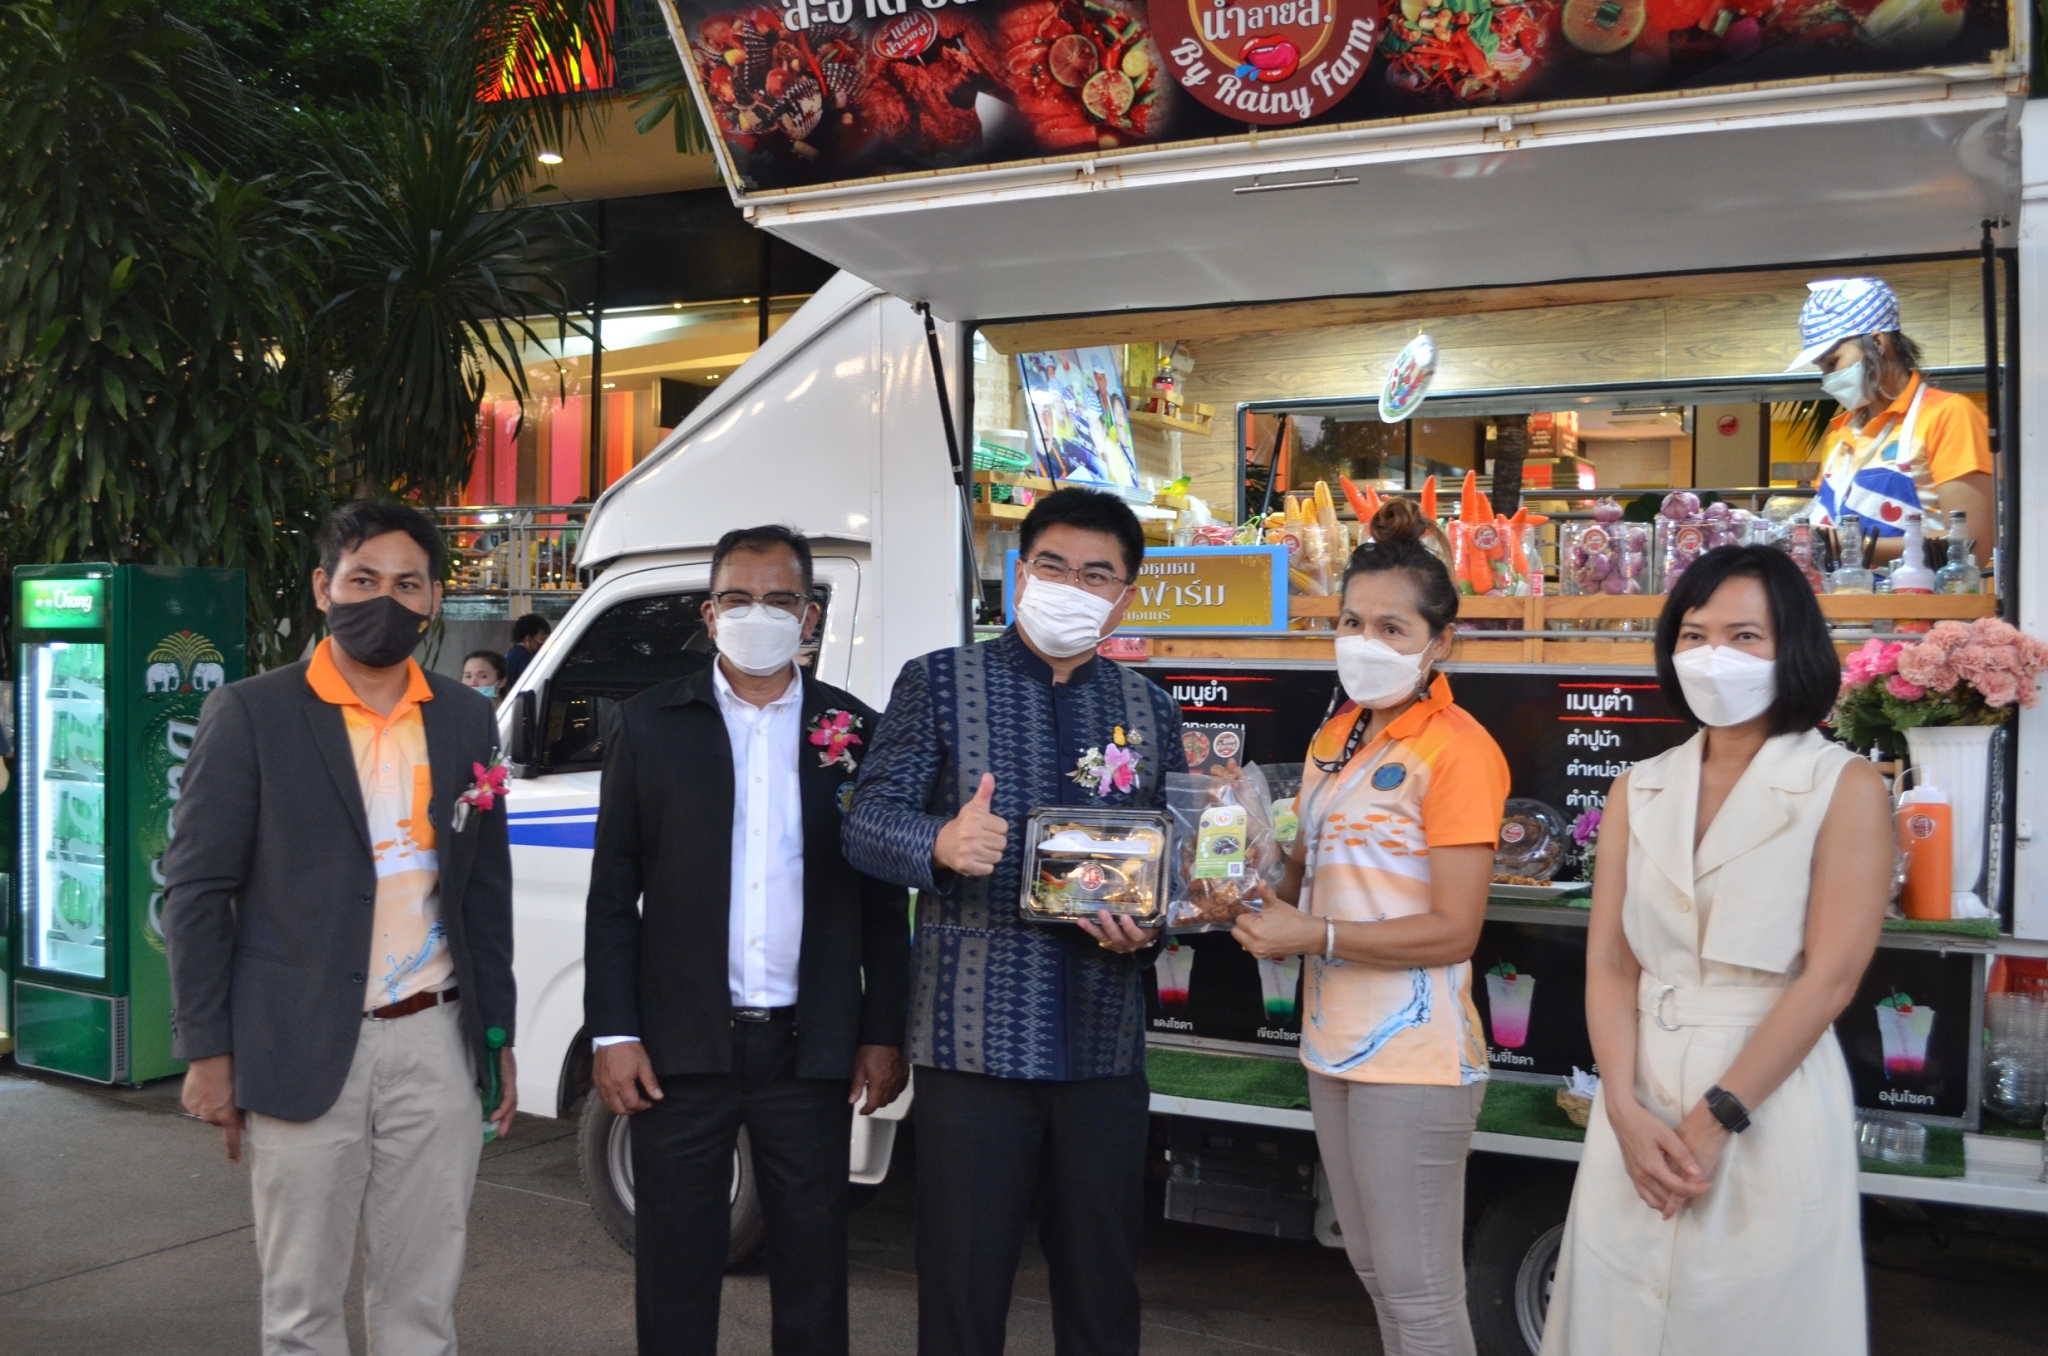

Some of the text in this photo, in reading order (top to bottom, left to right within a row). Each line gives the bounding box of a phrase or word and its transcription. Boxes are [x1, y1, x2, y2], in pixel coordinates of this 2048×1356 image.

[1170, 17, 1375, 119] By Rainy Farm
[54, 588, 93, 613] Chang
[1172, 679, 1228, 707] เมนูยำ
[1566, 687, 1633, 717] เมนูตำ
[1566, 728, 1621, 752] ตำปูม้า
[1153, 1017, 1194, 1031] แดงโซดา
[1878, 1088, 1935, 1106] องุ่นโซดา
